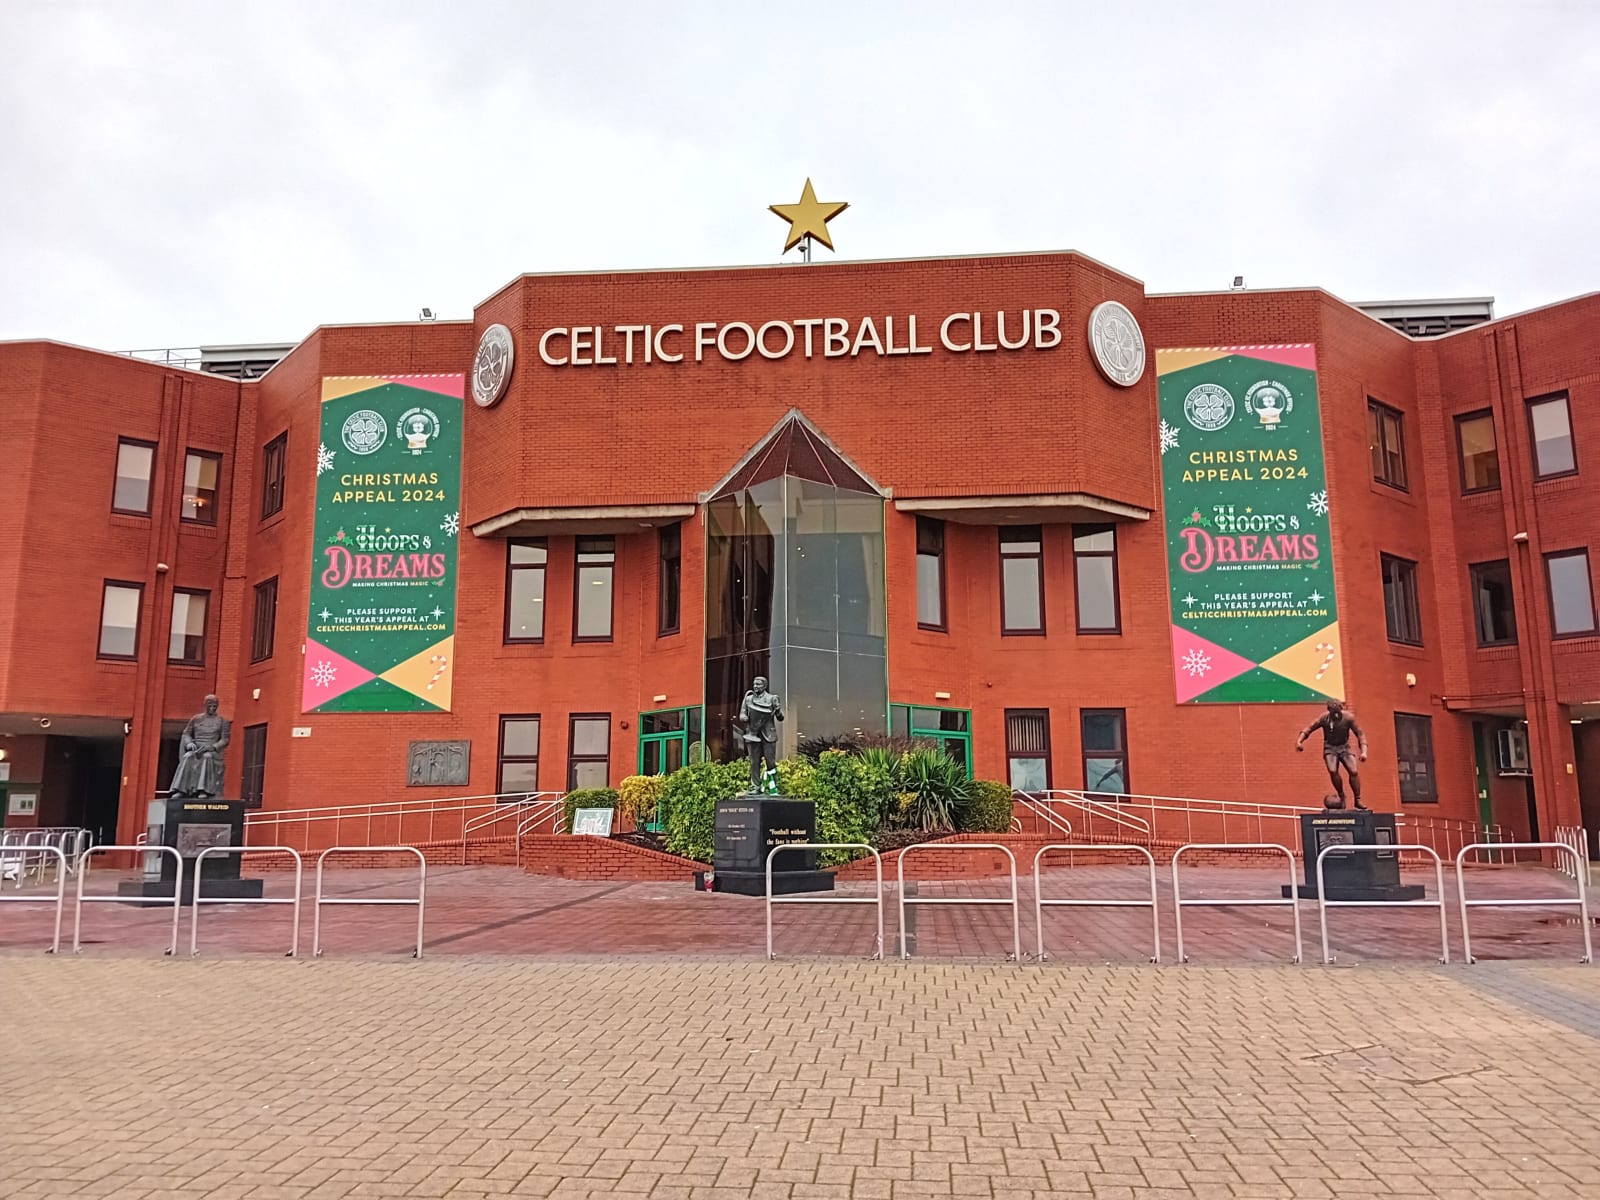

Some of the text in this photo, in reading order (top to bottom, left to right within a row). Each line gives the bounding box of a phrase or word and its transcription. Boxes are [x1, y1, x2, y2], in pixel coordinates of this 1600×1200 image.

[538, 323, 684, 366] CELTIC
[694, 315, 932, 362] FOOTBALL
[939, 308, 1063, 353] CLUB
[1189, 449, 1298, 464] CHRISTMAS
[341, 472, 438, 486] CHRISTMAS
[1182, 467, 1308, 482] APPEAL 2024
[332, 490, 445, 503] APPEAL 2024
[1289, 515, 1299, 530] &
[422, 535, 432, 549] &
[1180, 527, 1319, 573] DREAMS
[321, 545, 446, 589] DREAMS
[1214, 592, 1293, 600] PLEASE SUPPORT
[379, 607, 417, 615] SUPPORT
[1297, 600, 1307, 608] AT
[334, 616, 353, 624] THIS
[1182, 609, 1327, 619] CELTICCHRISTMASAPPEAL.COM
[316, 624, 446, 632] CELTICCHRISTMASAPPEAL.COM
